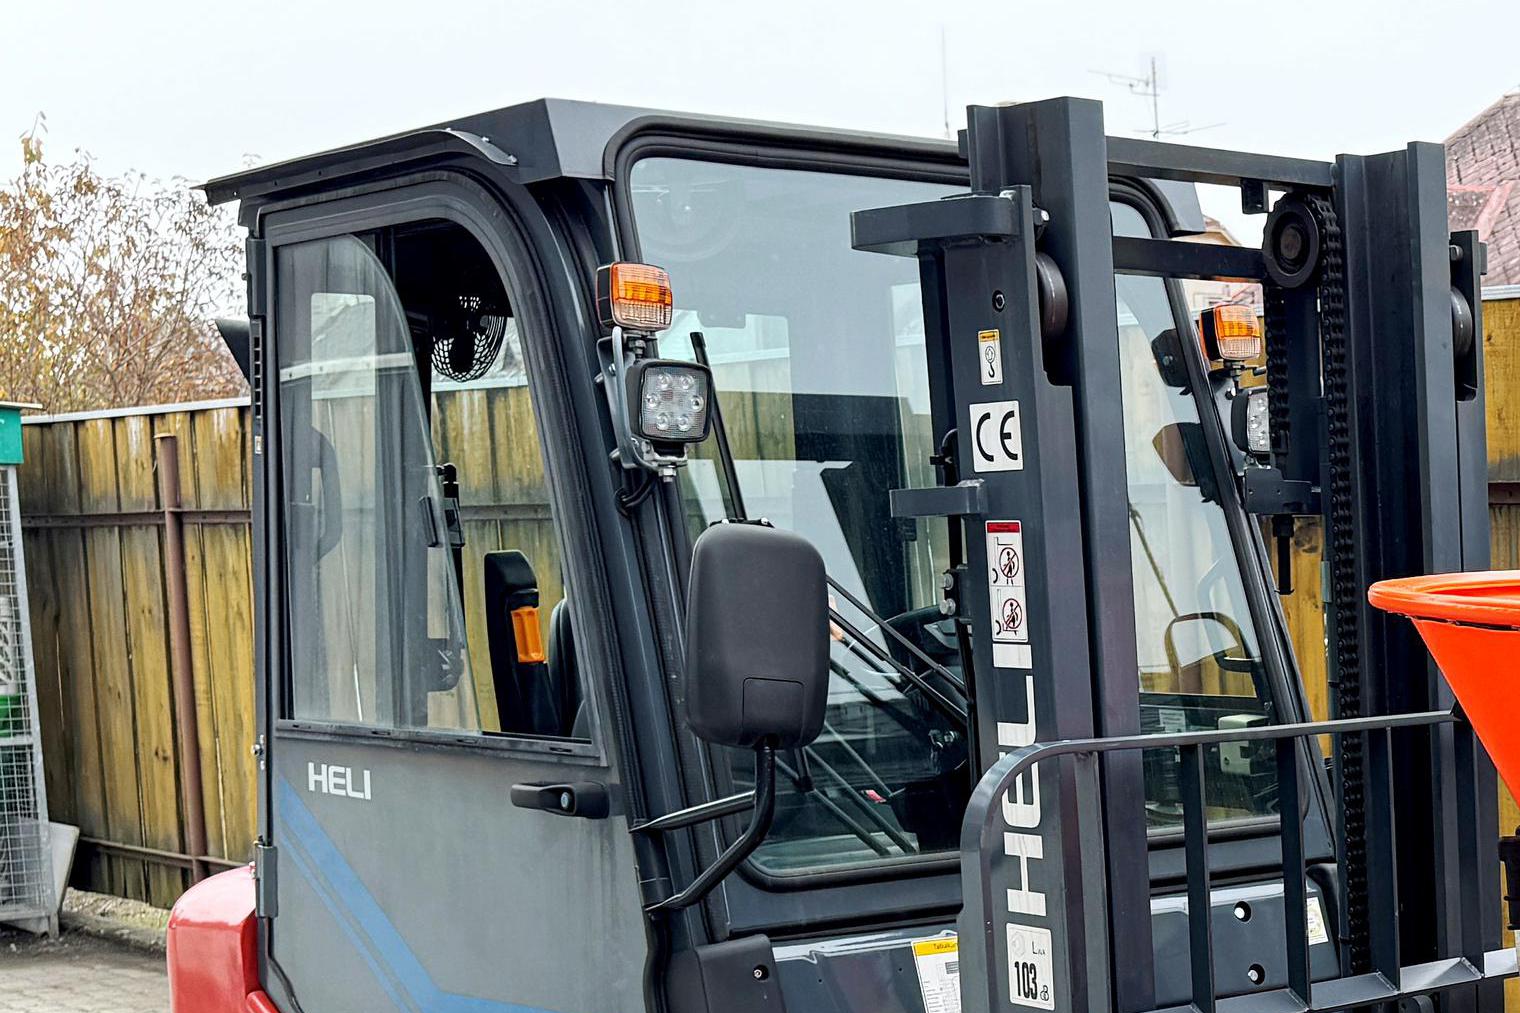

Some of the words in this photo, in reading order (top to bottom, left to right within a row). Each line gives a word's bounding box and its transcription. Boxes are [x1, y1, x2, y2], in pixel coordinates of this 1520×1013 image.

[976, 410, 1019, 463] CE
[307, 761, 372, 801] HELI
[1014, 960, 1038, 1000] 103
